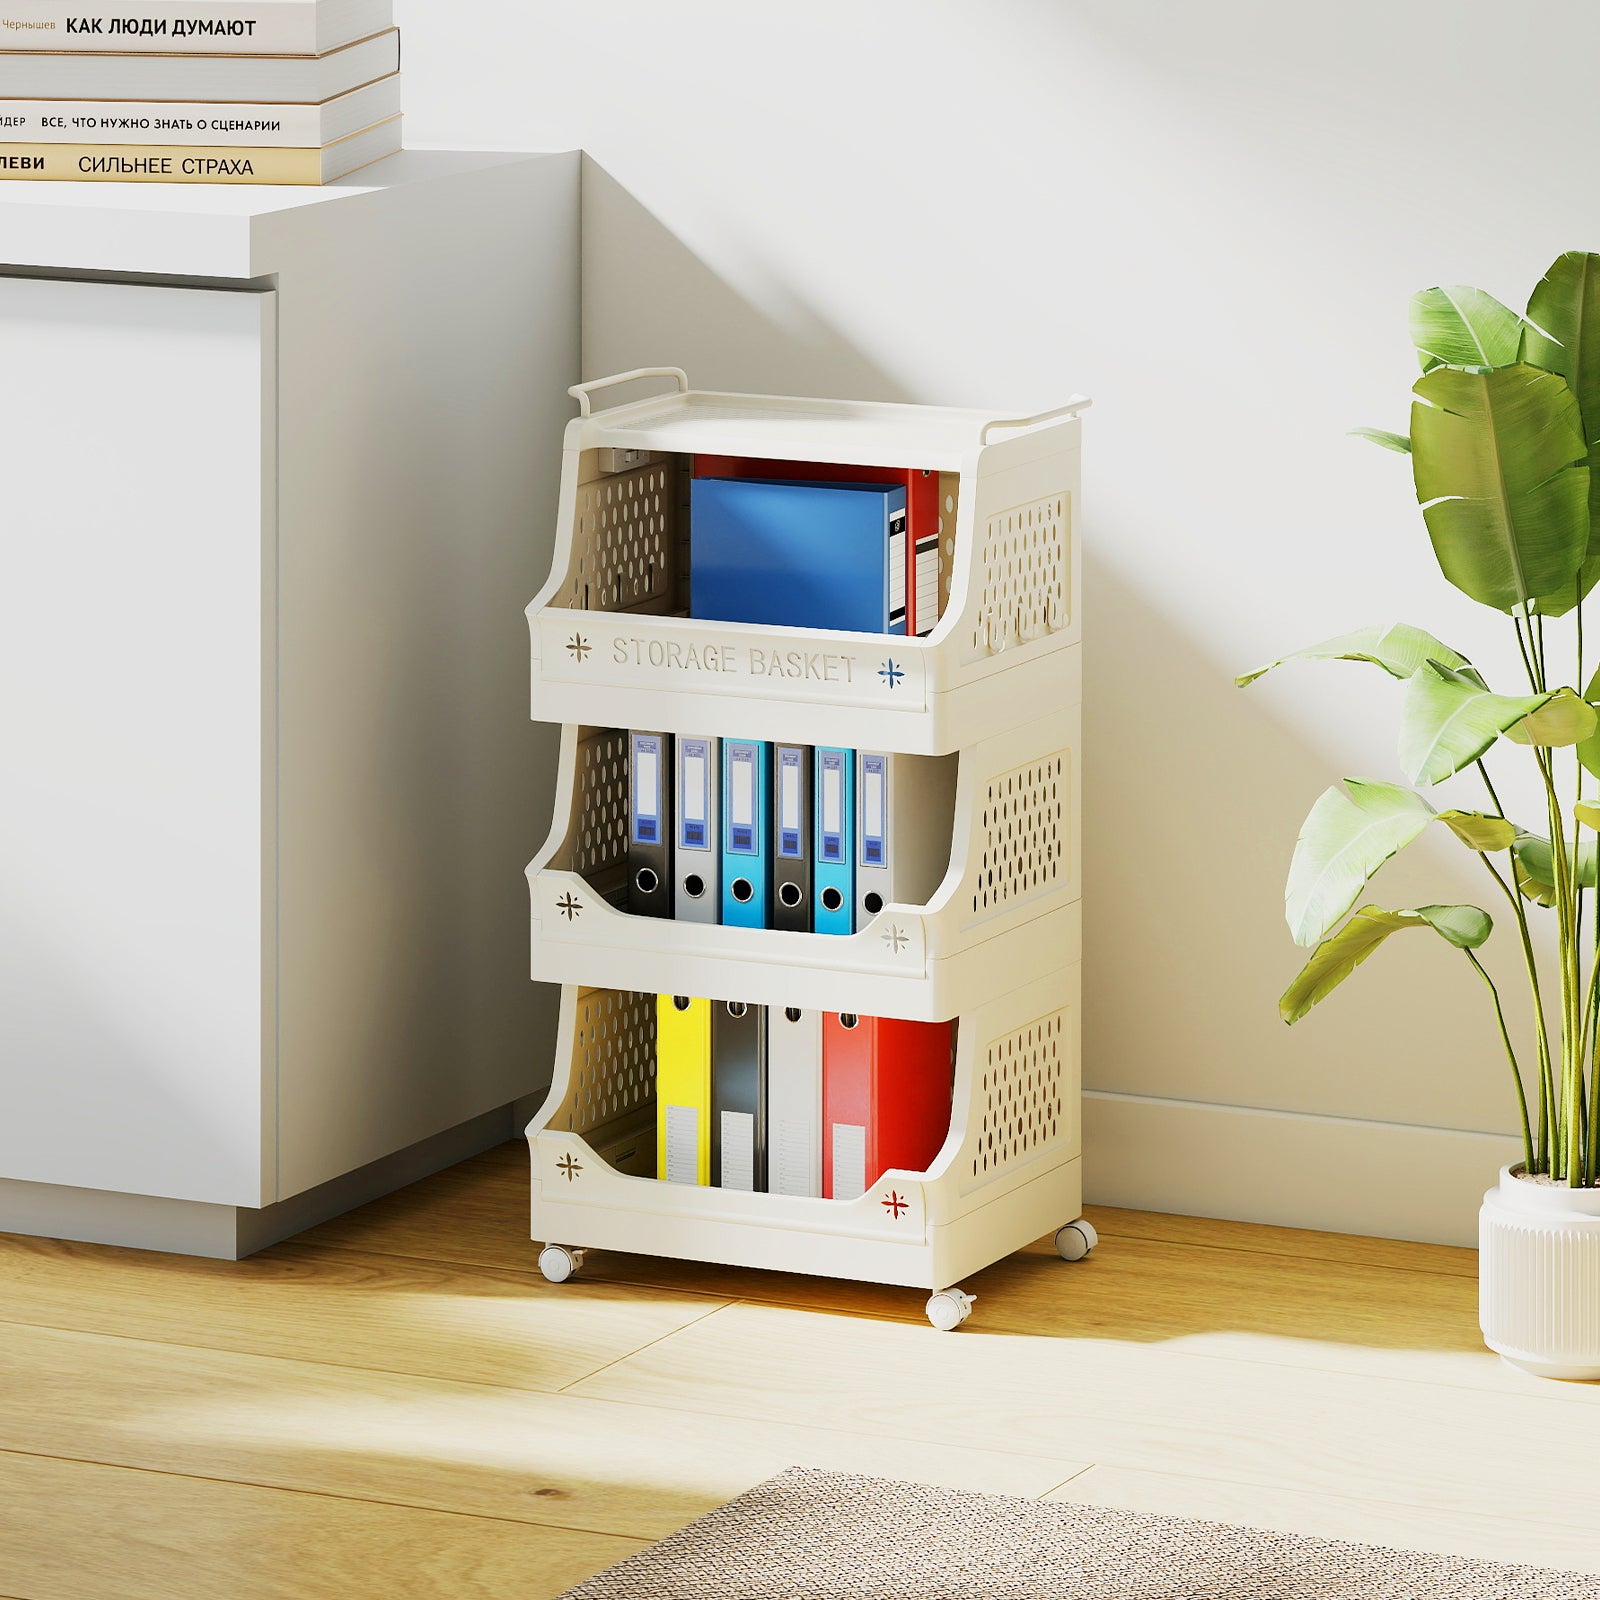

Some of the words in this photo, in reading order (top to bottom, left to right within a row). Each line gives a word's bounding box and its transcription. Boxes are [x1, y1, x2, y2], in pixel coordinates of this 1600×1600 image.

[2, 18, 56, 31] Чернышев
[66, 17, 103, 34] КАК
[108, 18, 167, 37] ЛЮДИ
[171, 19, 256, 37] ДУМАЮТ
[0, 115, 26, 127] ДЕР
[41, 117, 67, 128] ВСЕ,
[72, 117, 97, 128] ЧТО
[100, 118, 150, 129] НУЖНО
[154, 119, 193, 130] ЗНАТЬ
[196, 119, 208, 130] О
[211, 120, 281, 132] СЦЕНАРИИ
[78, 156, 173, 174] СИЛЬНЕЕ
[181, 157, 254, 176] СТРАХА
[612, 637, 738, 673] STORAGE
[749, 648, 857, 683] BASKET
